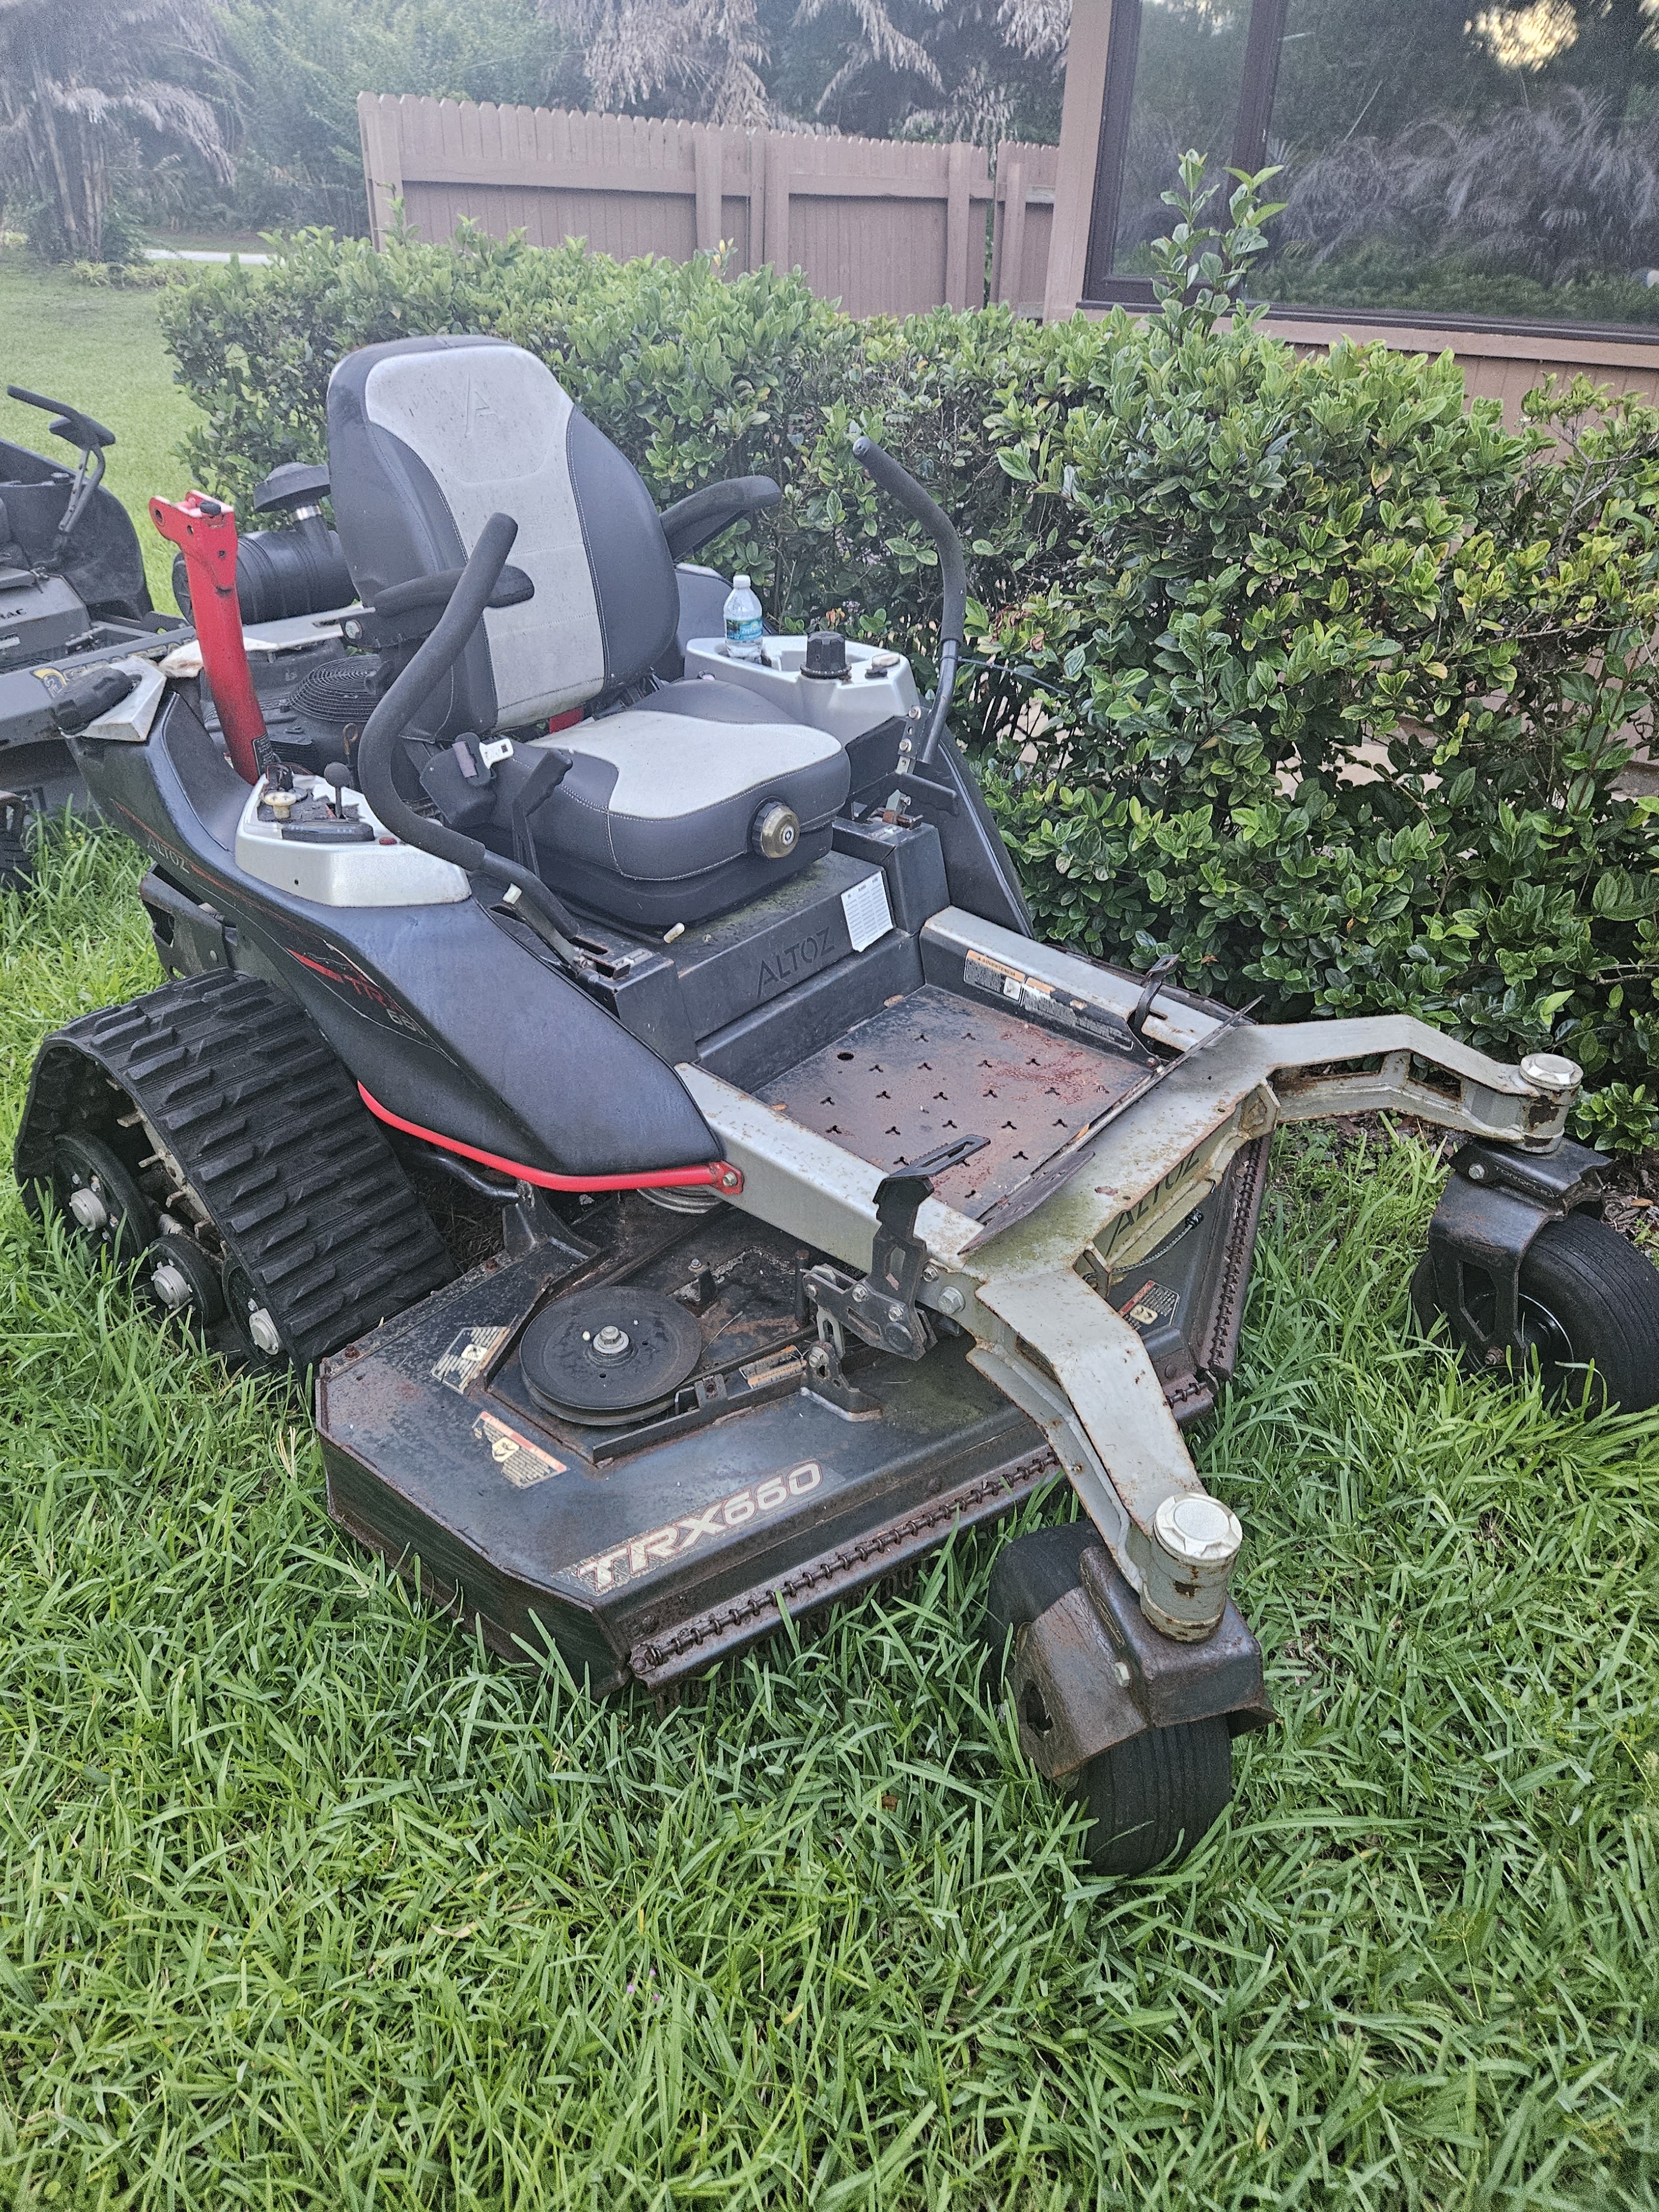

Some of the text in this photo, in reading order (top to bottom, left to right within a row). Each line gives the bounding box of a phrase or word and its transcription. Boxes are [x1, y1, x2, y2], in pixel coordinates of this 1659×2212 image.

[147, 834, 190, 874] ALTOZ
[757, 926, 836, 1000] ALTOZ
[577, 1460, 823, 1592] TRX660
